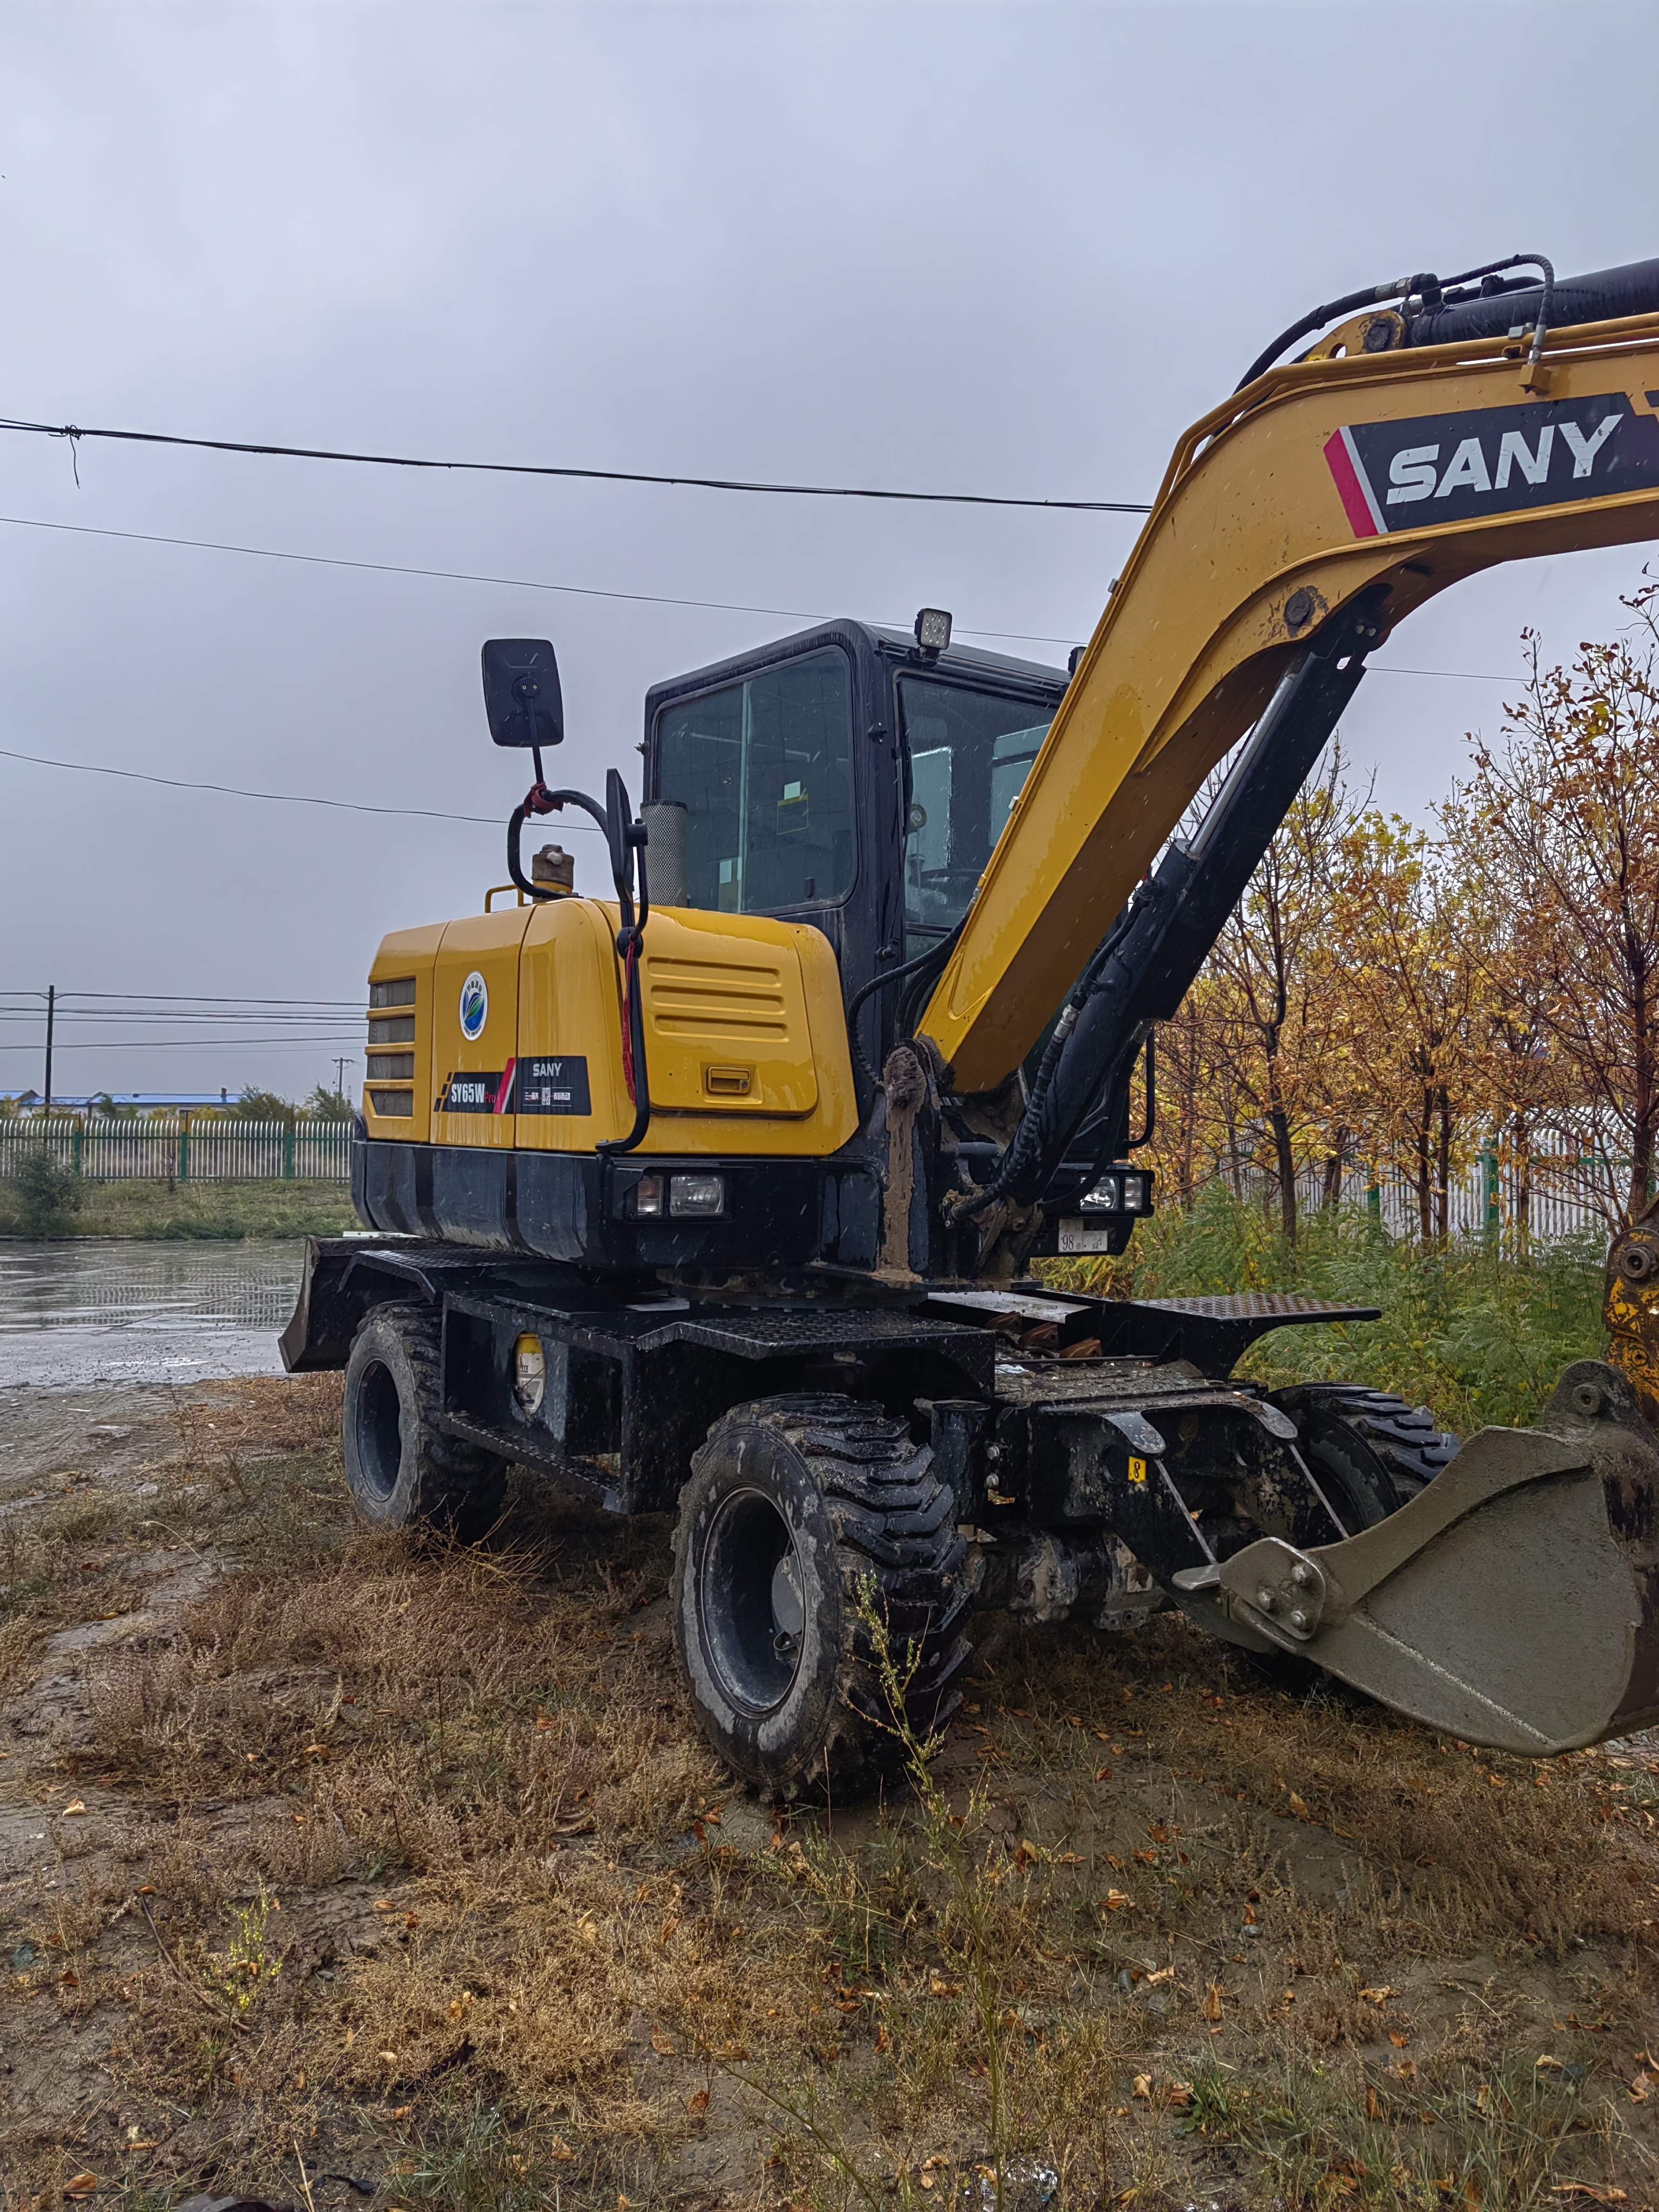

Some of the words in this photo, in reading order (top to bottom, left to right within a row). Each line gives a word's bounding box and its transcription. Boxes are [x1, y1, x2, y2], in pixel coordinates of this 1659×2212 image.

[1386, 414, 1624, 505] SANY
[532, 1063, 562, 1077] SANY
[451, 1083, 485, 1103] SY65W
[485, 1092, 496, 1103] Pro
[1063, 1235, 1074, 1250] 98
